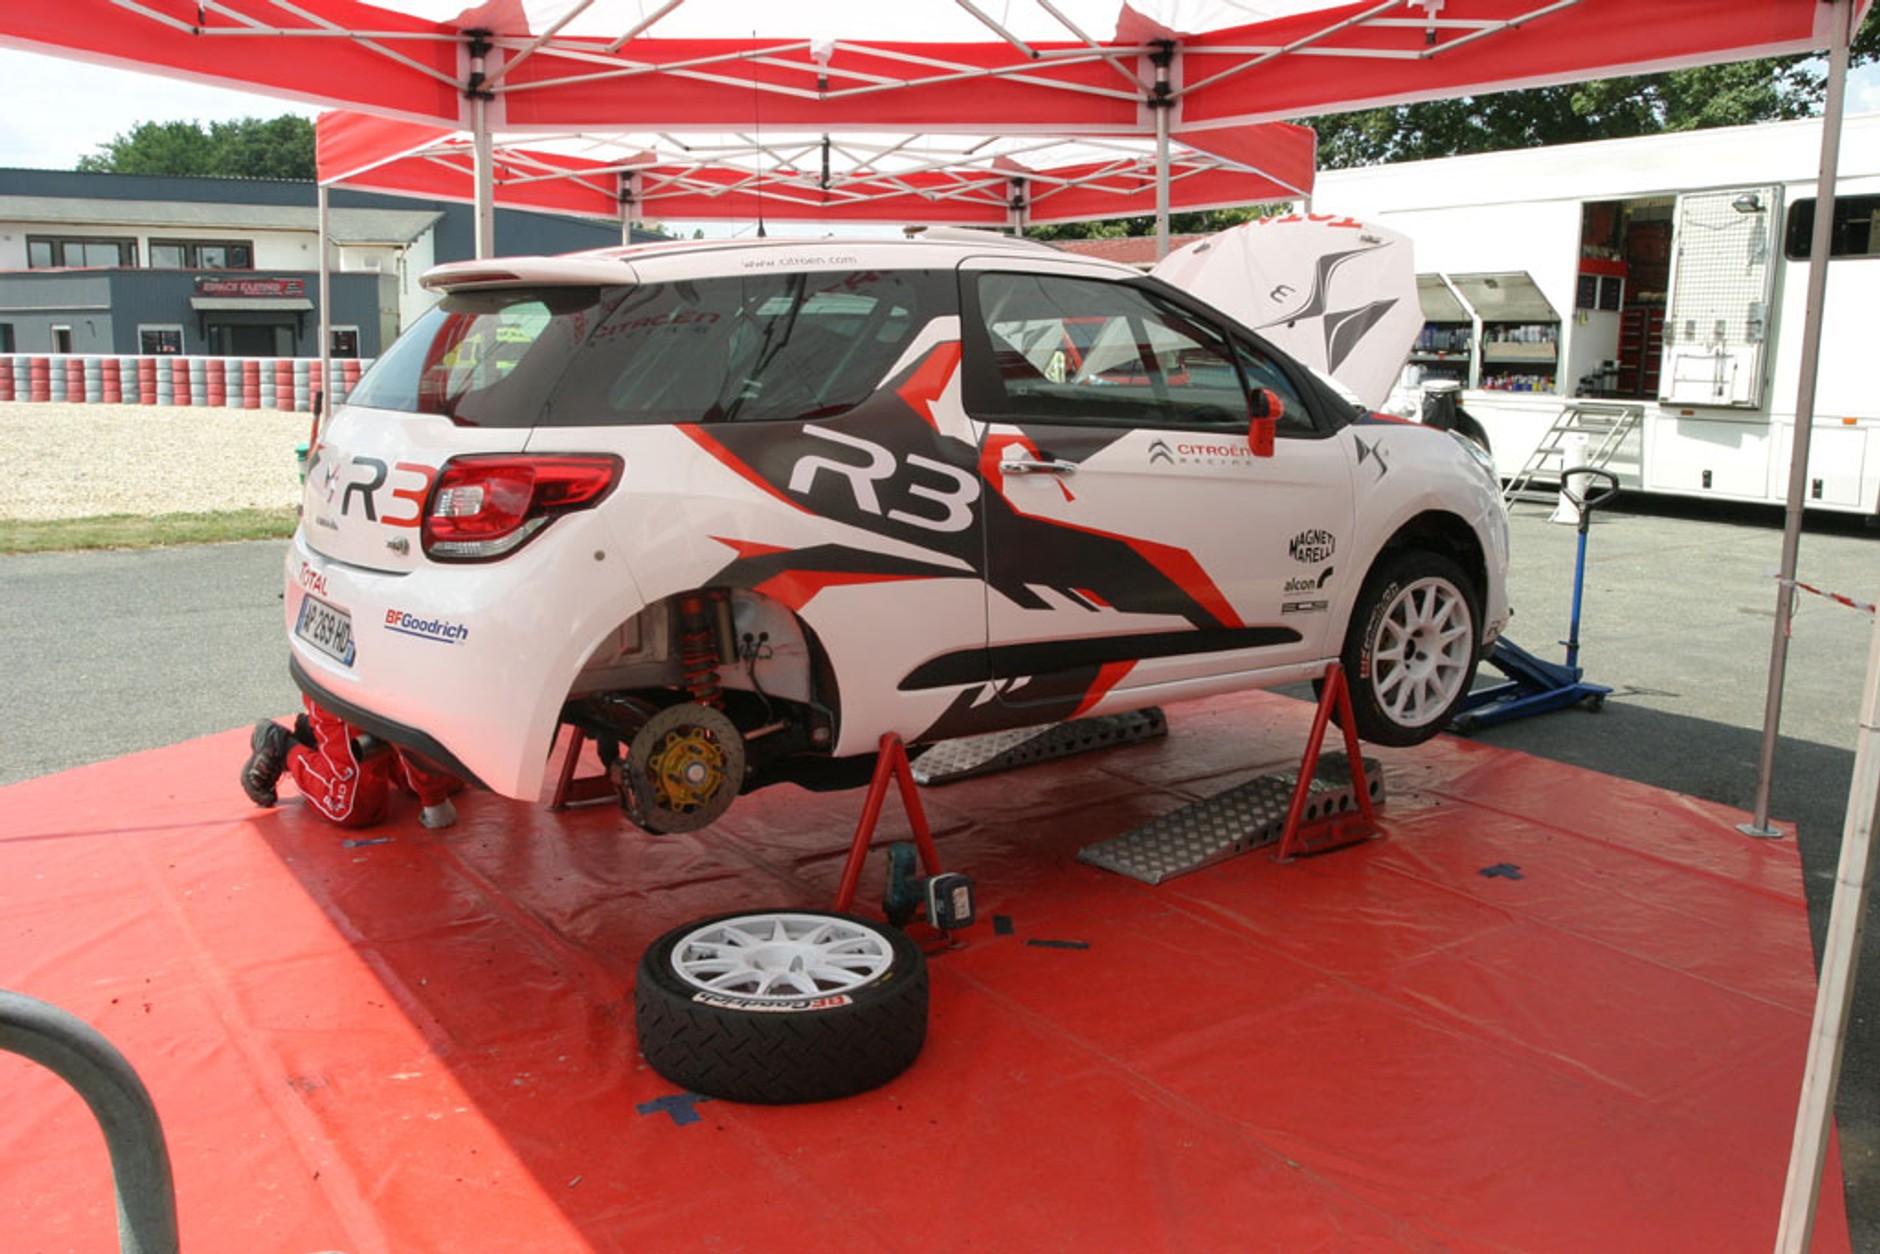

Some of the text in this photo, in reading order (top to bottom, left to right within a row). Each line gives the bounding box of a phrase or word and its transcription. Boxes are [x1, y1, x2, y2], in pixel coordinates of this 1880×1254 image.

[341, 456, 439, 528] R3
[788, 424, 980, 532] R3
[301, 562, 327, 596] TOTAL
[1284, 577, 1316, 592] alcon
[385, 609, 468, 640] BFGoodrich
[699, 993, 845, 1010] BFGoodrich
